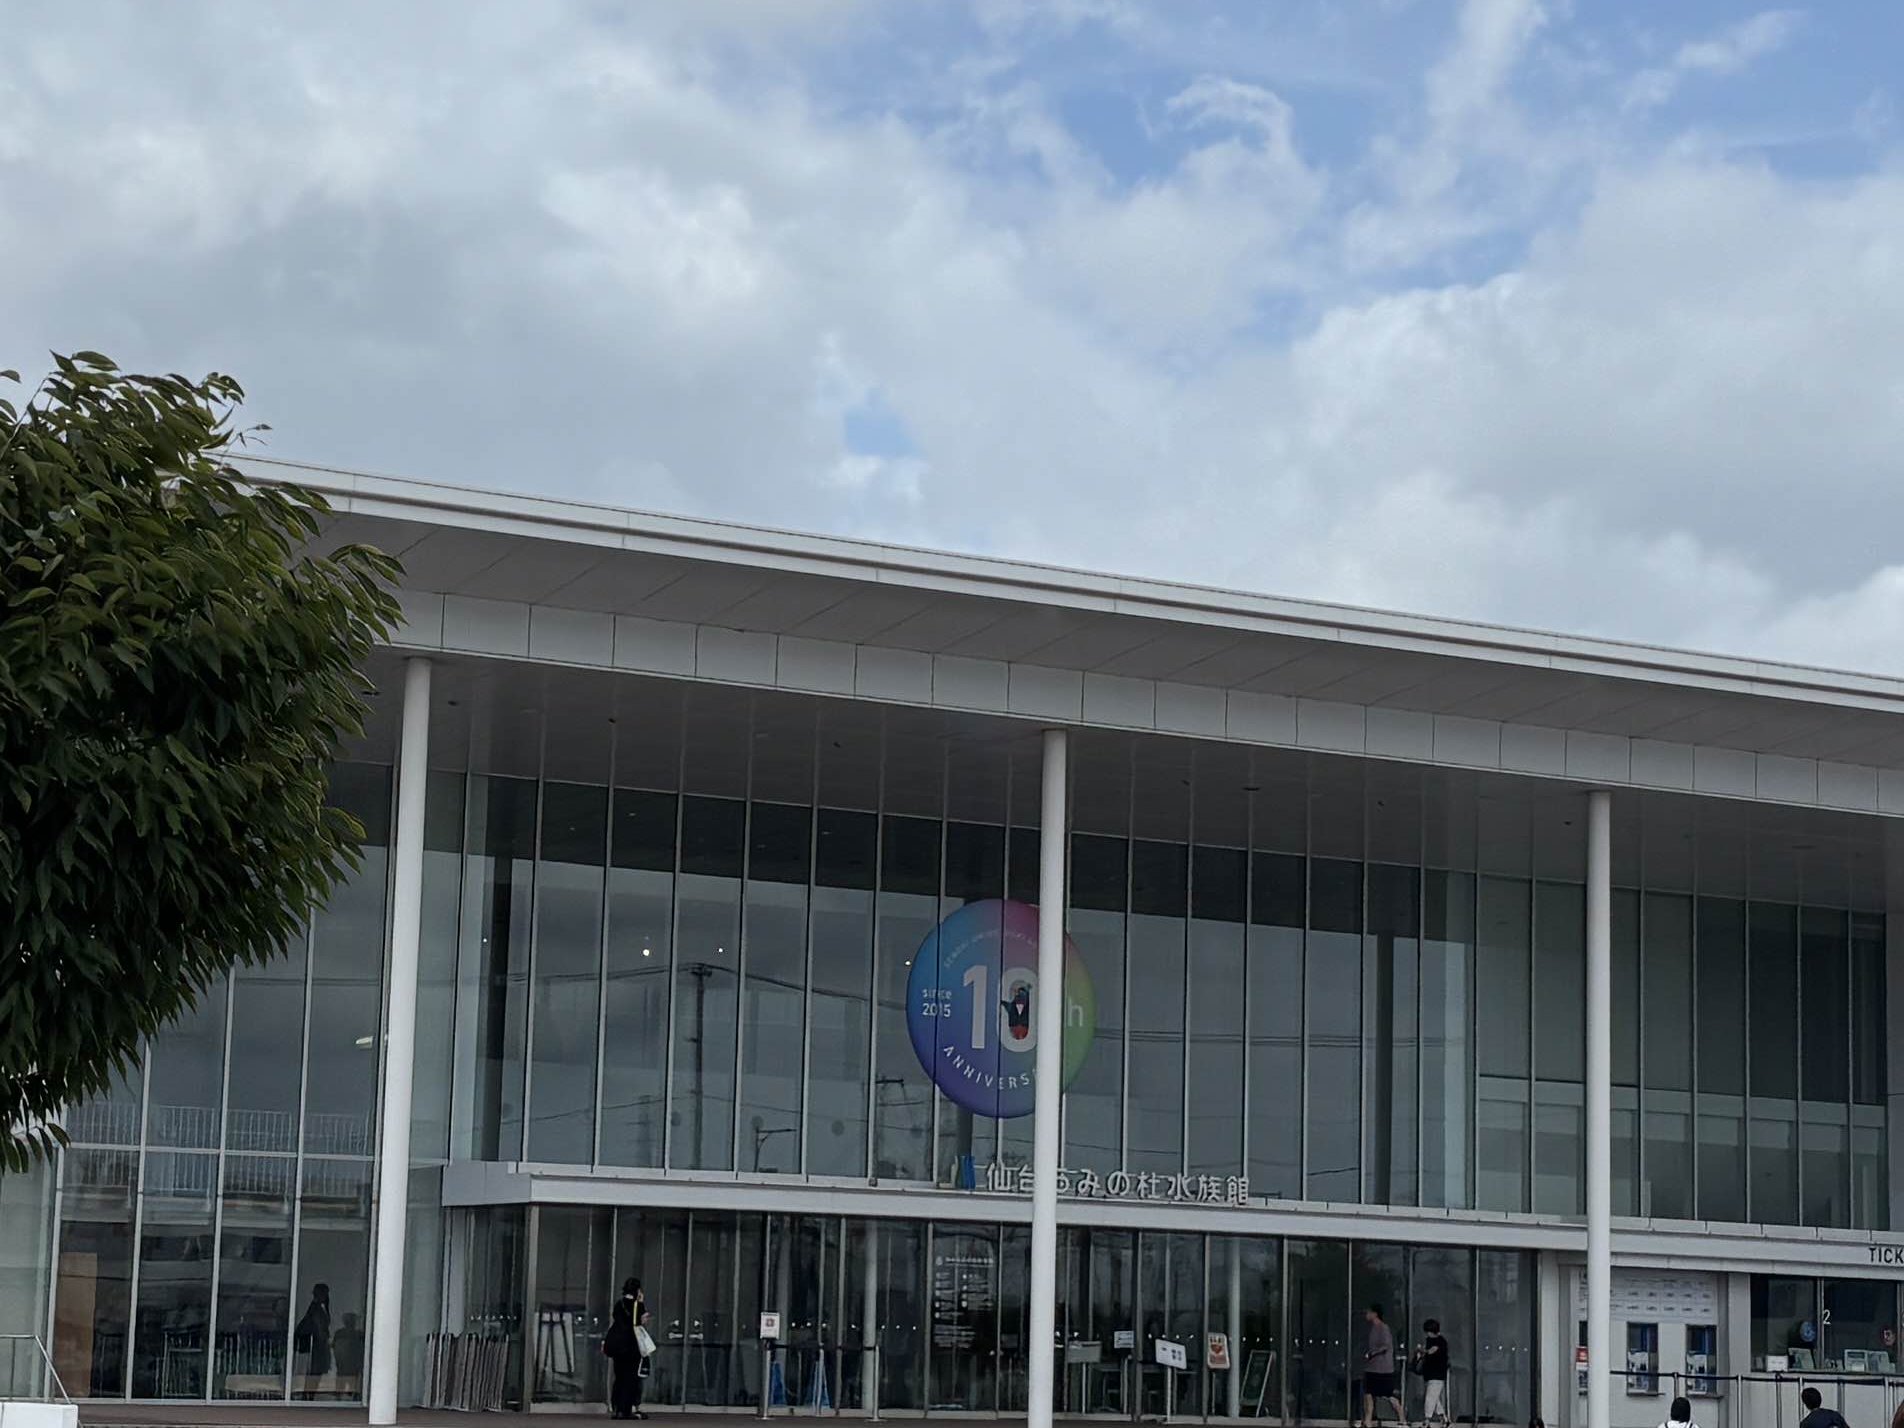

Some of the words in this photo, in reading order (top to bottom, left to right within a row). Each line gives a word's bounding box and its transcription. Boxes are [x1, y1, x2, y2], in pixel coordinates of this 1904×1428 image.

[922, 1002, 951, 1018] 2015
[943, 1044, 1038, 1090] ANNIVERS
[1823, 1309, 1831, 1325] 2
